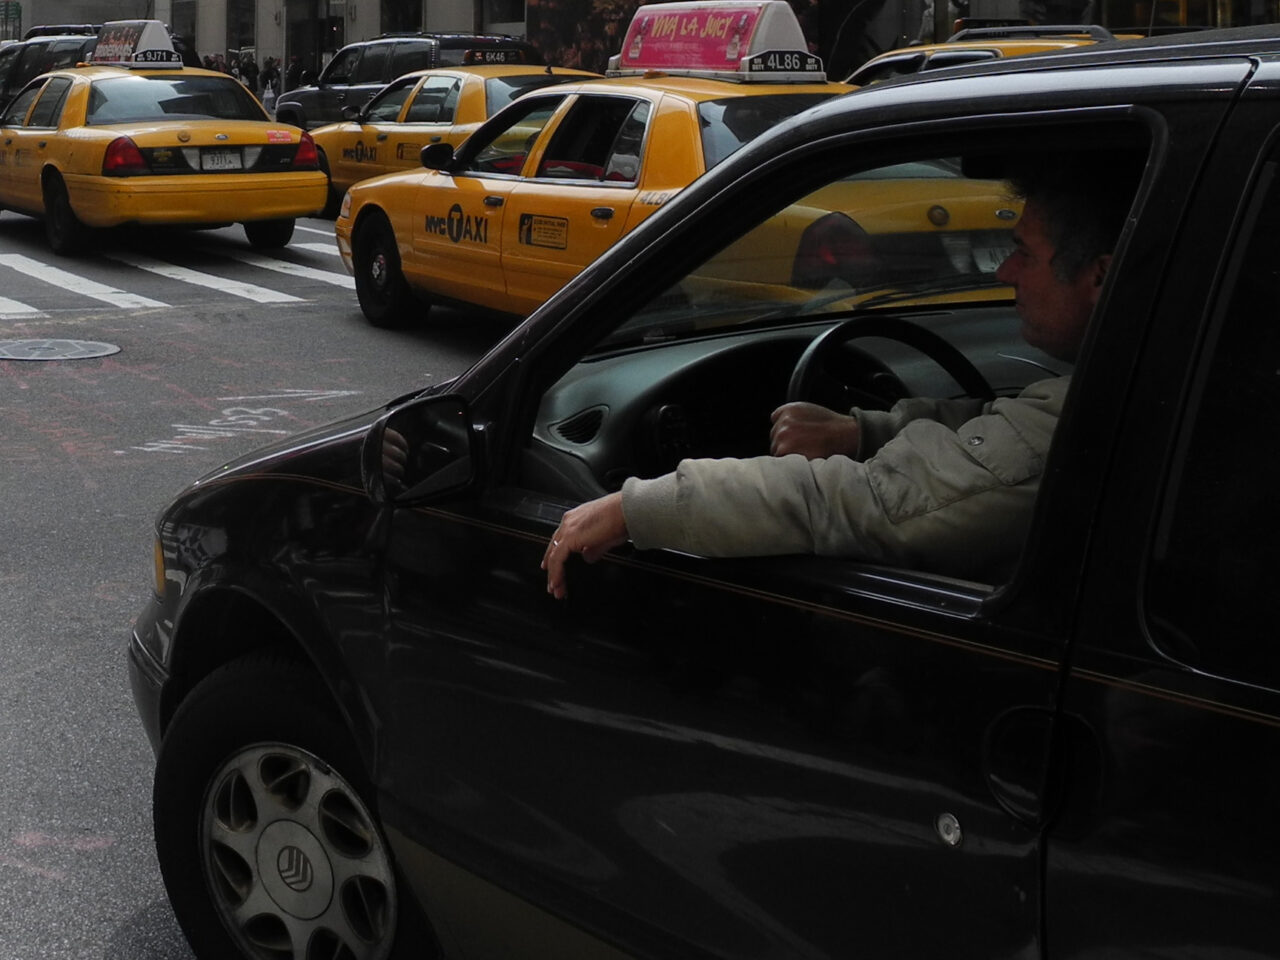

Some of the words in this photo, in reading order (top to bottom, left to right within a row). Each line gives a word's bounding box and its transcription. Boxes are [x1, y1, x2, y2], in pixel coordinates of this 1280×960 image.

[651, 15, 679, 41] VIVA
[680, 16, 698, 36] LA
[700, 14, 734, 39] JUICY
[146, 51, 167, 61] 9J71
[485, 52, 506, 62] 6K46
[767, 53, 801, 69] 4L86
[424, 214, 447, 236] NYC
[447, 203, 488, 244] TAXI
